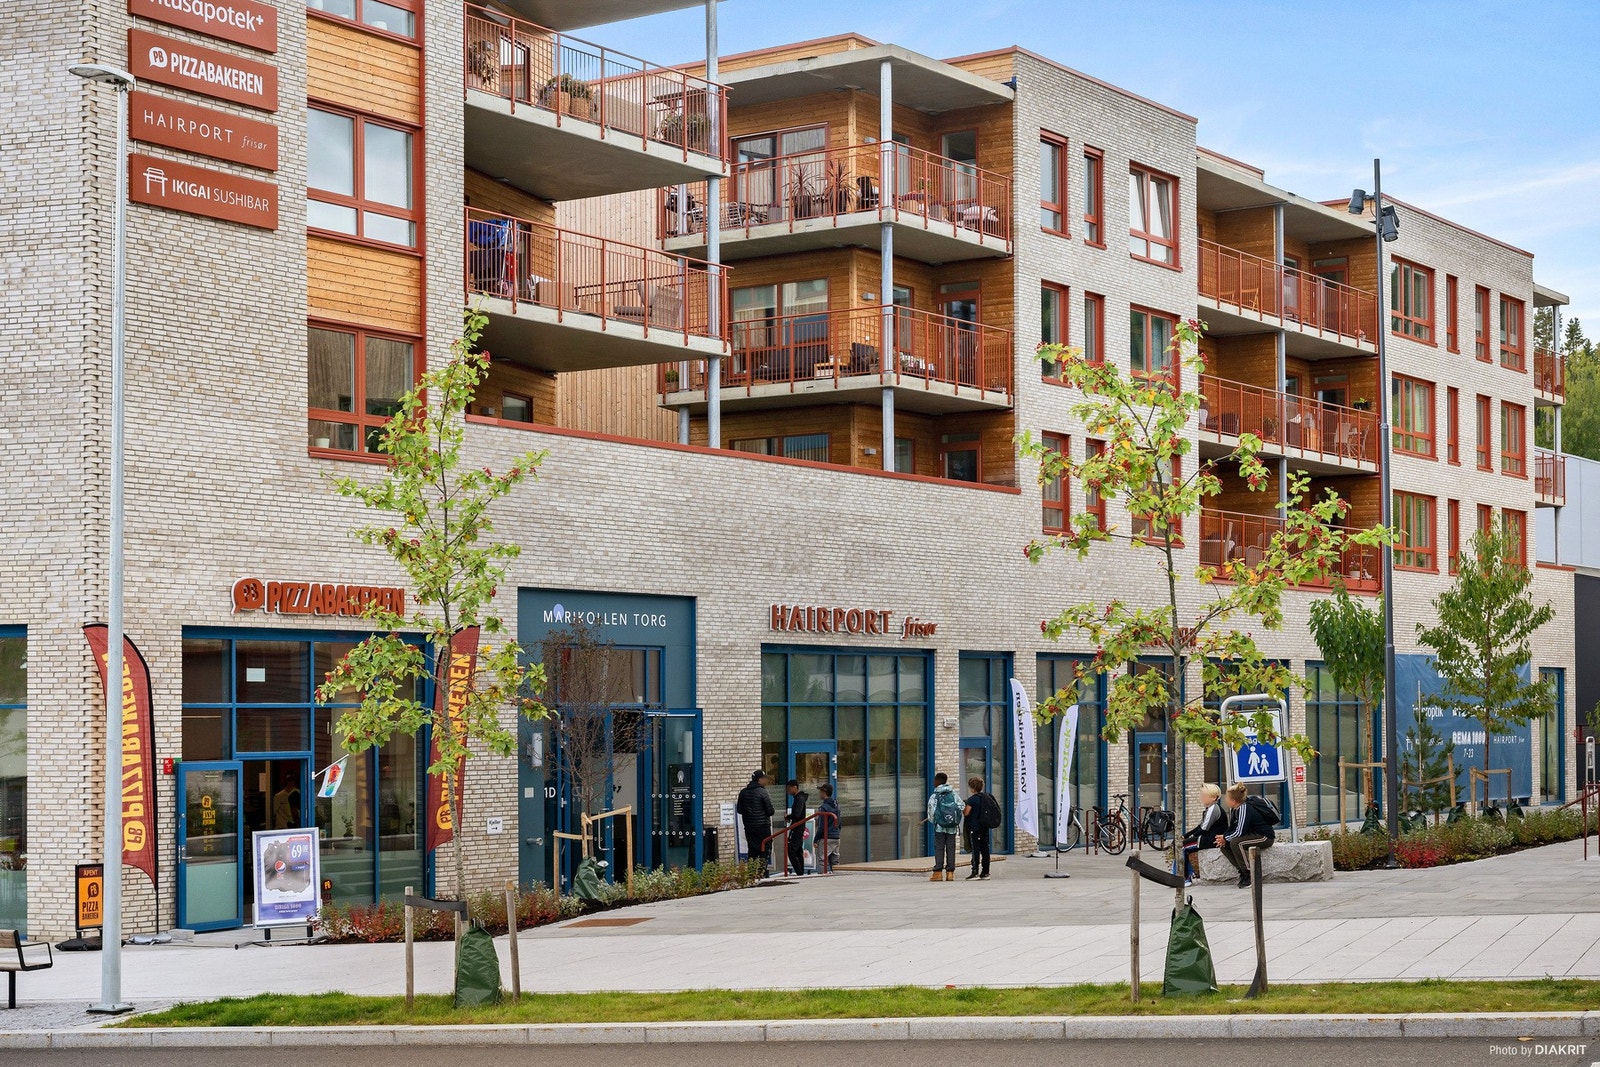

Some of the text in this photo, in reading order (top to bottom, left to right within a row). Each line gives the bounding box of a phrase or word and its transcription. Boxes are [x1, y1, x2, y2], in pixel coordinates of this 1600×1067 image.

[170, 52, 263, 95] PIZZABAKEREN
[144, 110, 268, 149] HAIRPORT frisør
[172, 179, 269, 212] IKIGAI SUSHIBAR
[265, 581, 405, 618] PIZZABAKEREN
[634, 613, 667, 627] TORG
[770, 603, 939, 640] HAIRPORT frisør
[1411, 704, 1444, 720] ieroptik
[1452, 731, 1471, 745] REMA
[1493, 735, 1517, 744] HAIRPORT
[1463, 748, 1474, 758] 7-23
[543, 787, 557, 798] 1D
[291, 844, 302, 858] 69
[82, 901, 99, 912] PIZZA
